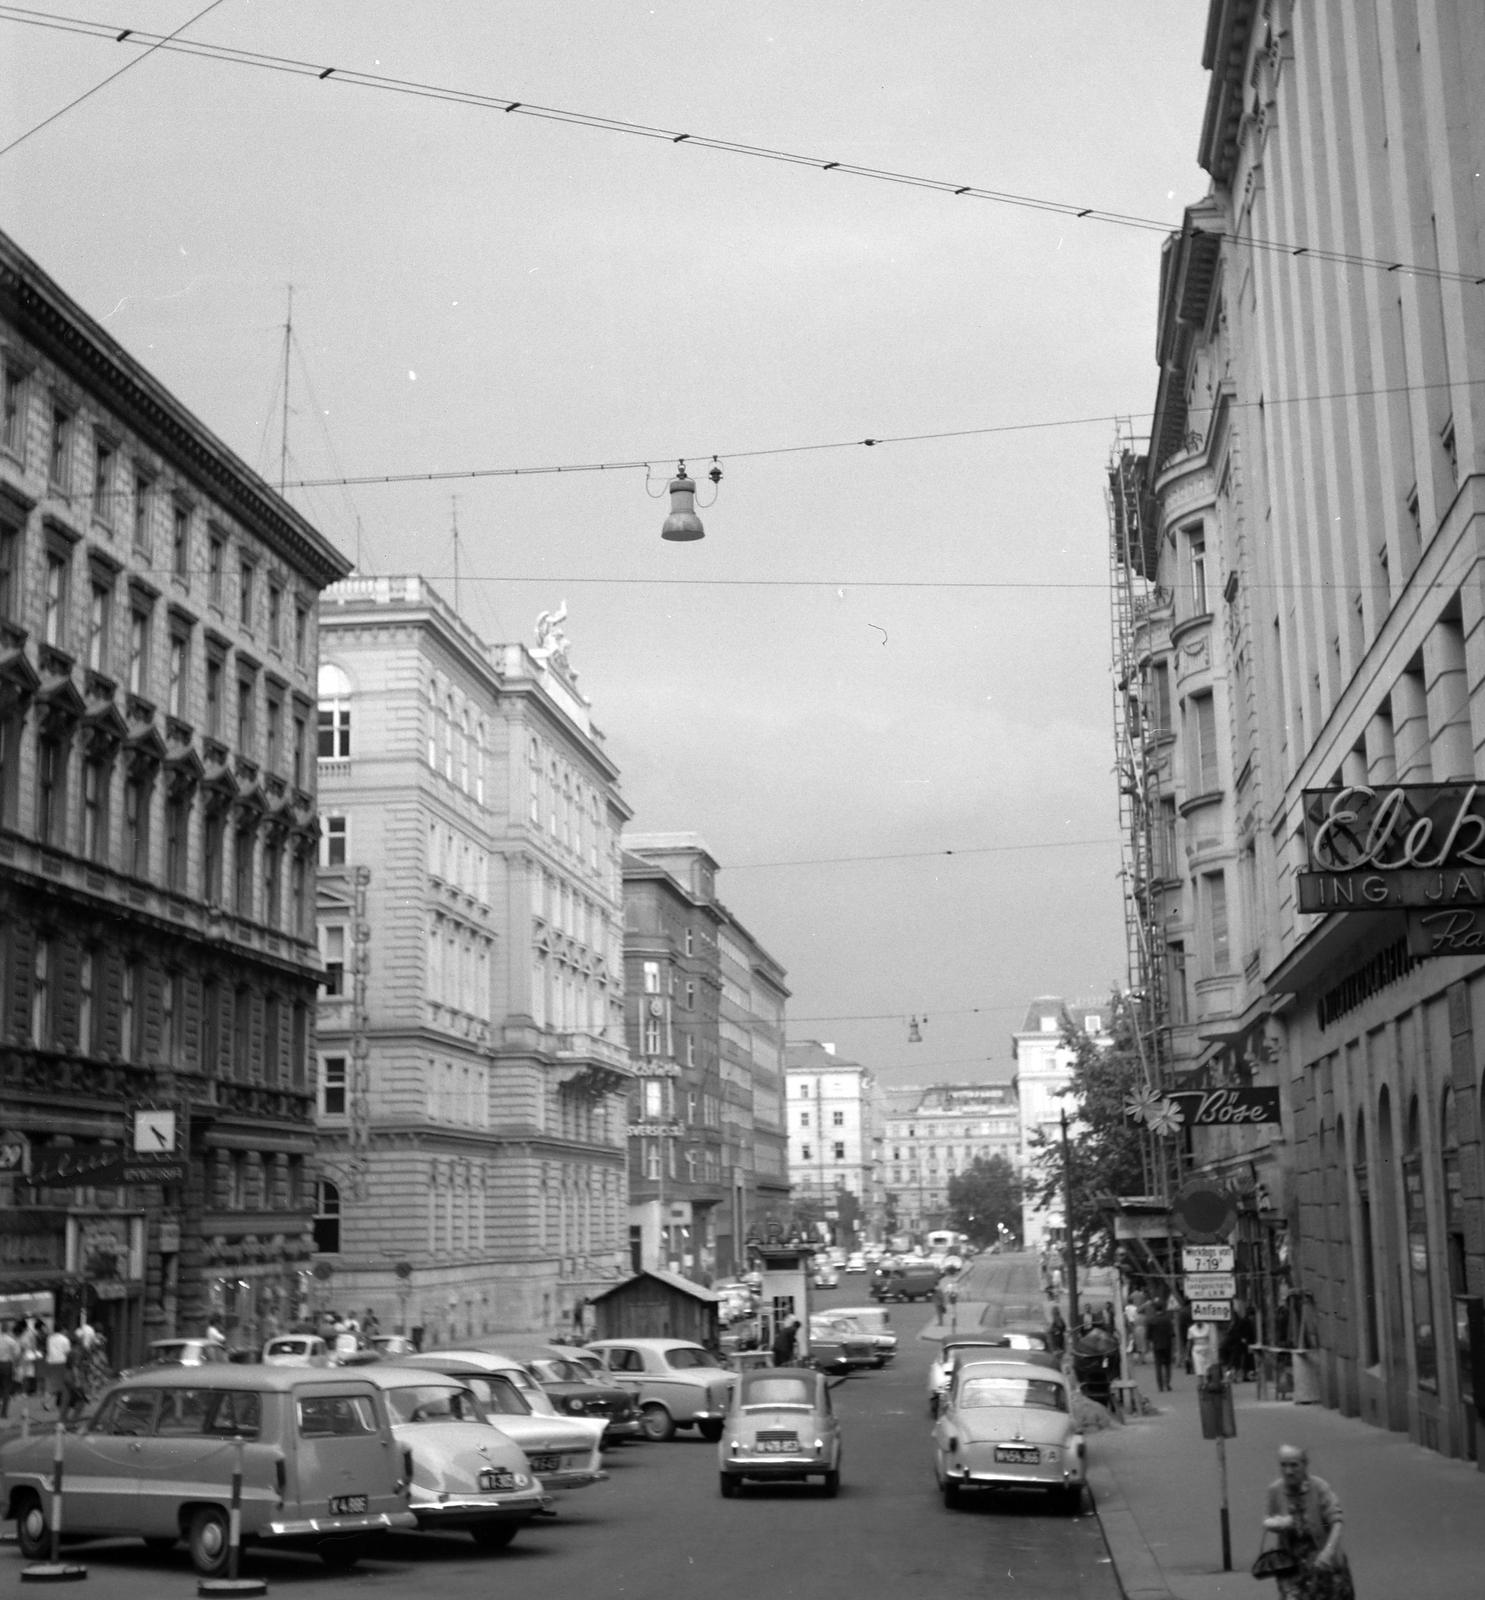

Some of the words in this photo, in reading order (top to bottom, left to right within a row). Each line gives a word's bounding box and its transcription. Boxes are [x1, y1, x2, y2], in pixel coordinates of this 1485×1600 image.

[1425, 868, 1485, 899] JA
[1166, 1089, 1268, 1122] Böse
[1194, 1304, 1230, 1318] Anfang
